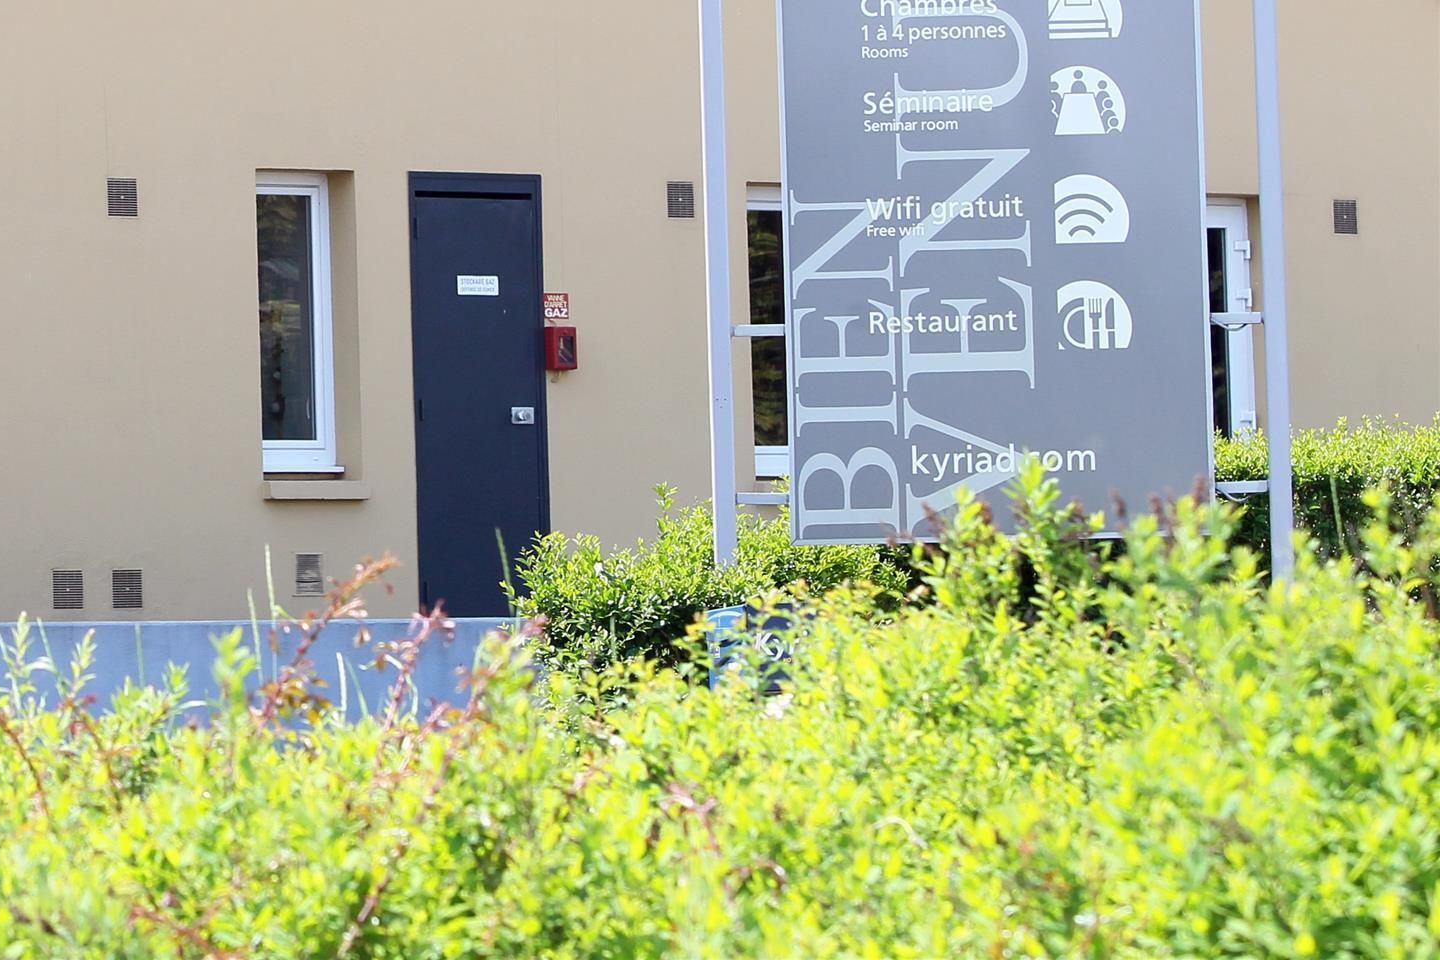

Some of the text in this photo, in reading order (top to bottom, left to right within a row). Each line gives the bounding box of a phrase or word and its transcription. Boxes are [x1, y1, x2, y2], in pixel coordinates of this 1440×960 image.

[861, 24, 1007, 45] 1 à 4 personnes
[861, 46, 909, 59] Rooms
[863, 89, 993, 115] Séminaire
[863, 118, 960, 133] Seminar room
[866, 193, 1024, 225] Wifi gratuit
[866, 222, 925, 237] Free wifi
[544, 307, 568, 318] GAZ
[869, 310, 1018, 335] Restaurant
[790, 189, 900, 540] BIEN
